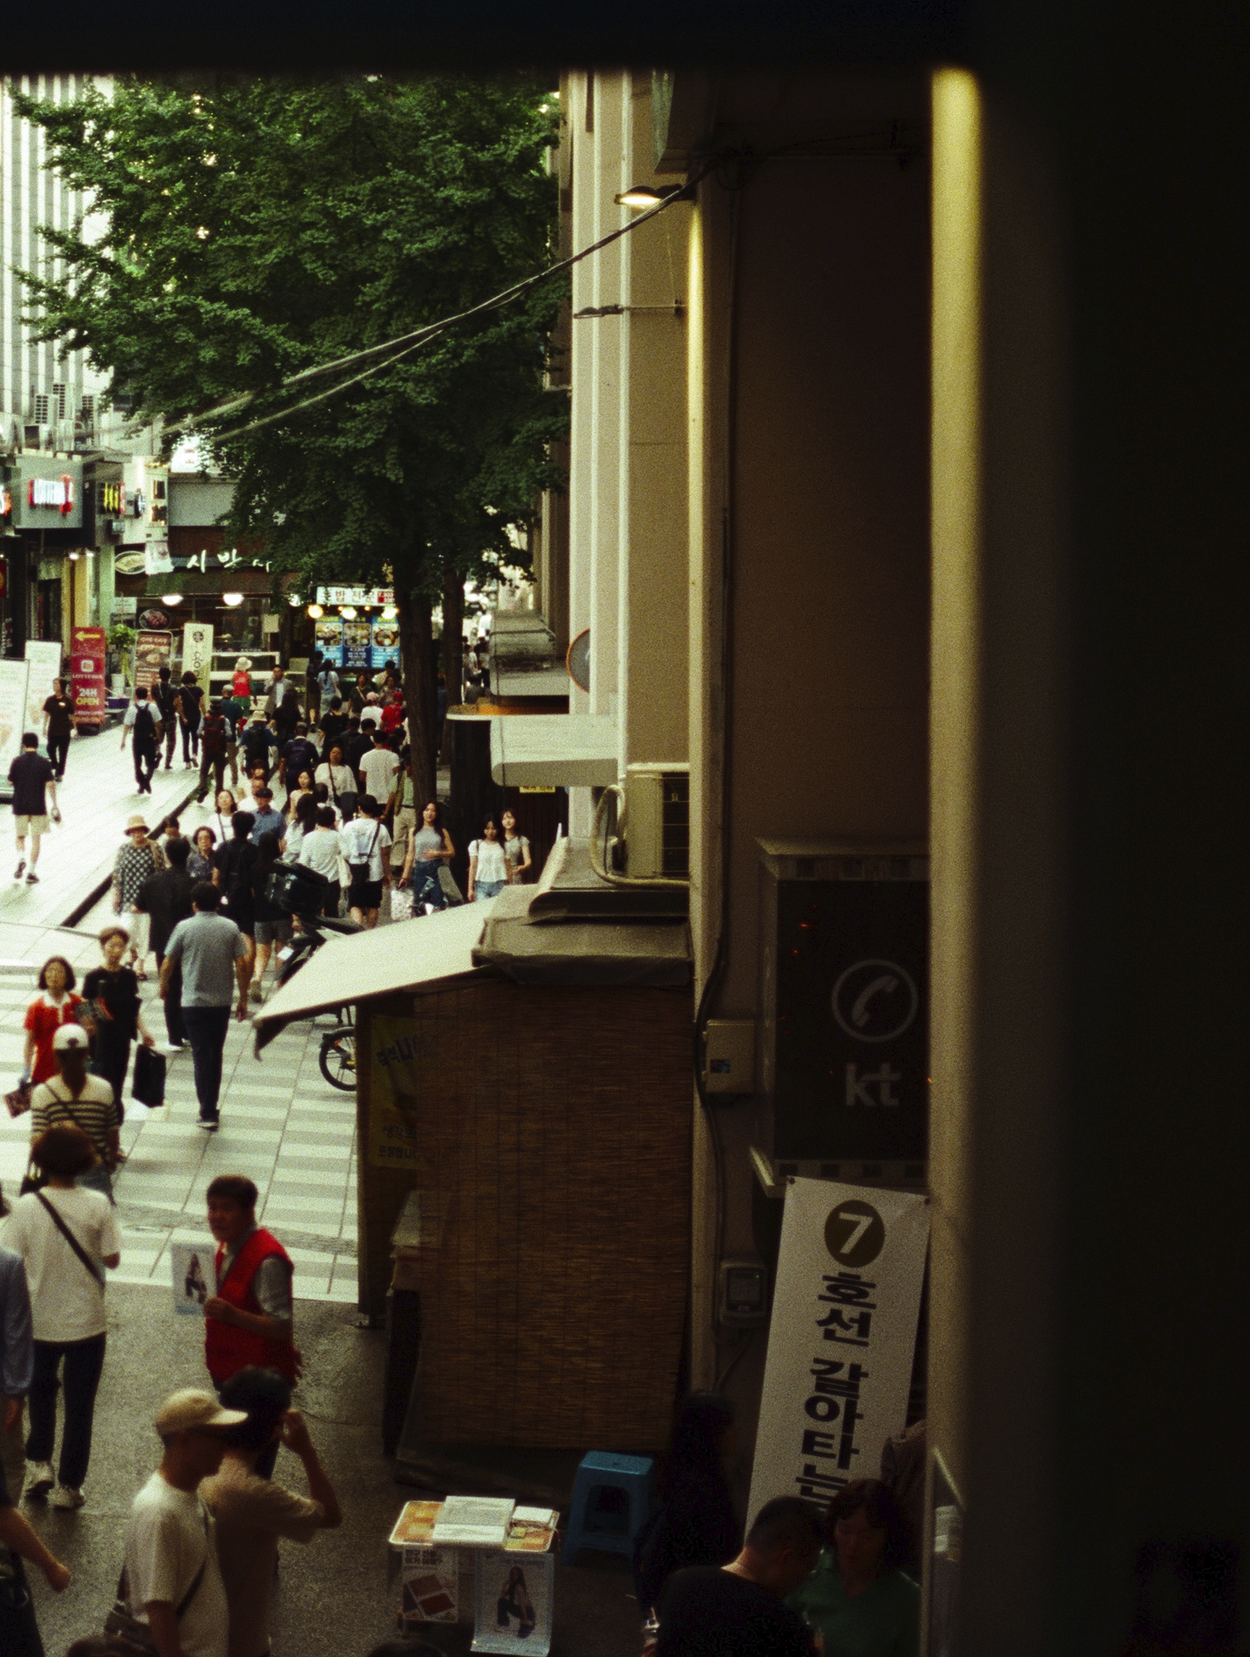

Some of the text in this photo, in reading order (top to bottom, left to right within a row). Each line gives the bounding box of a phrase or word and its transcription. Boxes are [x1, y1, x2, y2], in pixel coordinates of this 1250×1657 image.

[79, 688, 98, 697] 24H
[75, 697, 100, 706] OPEN
[843, 1063, 902, 1107] kt
